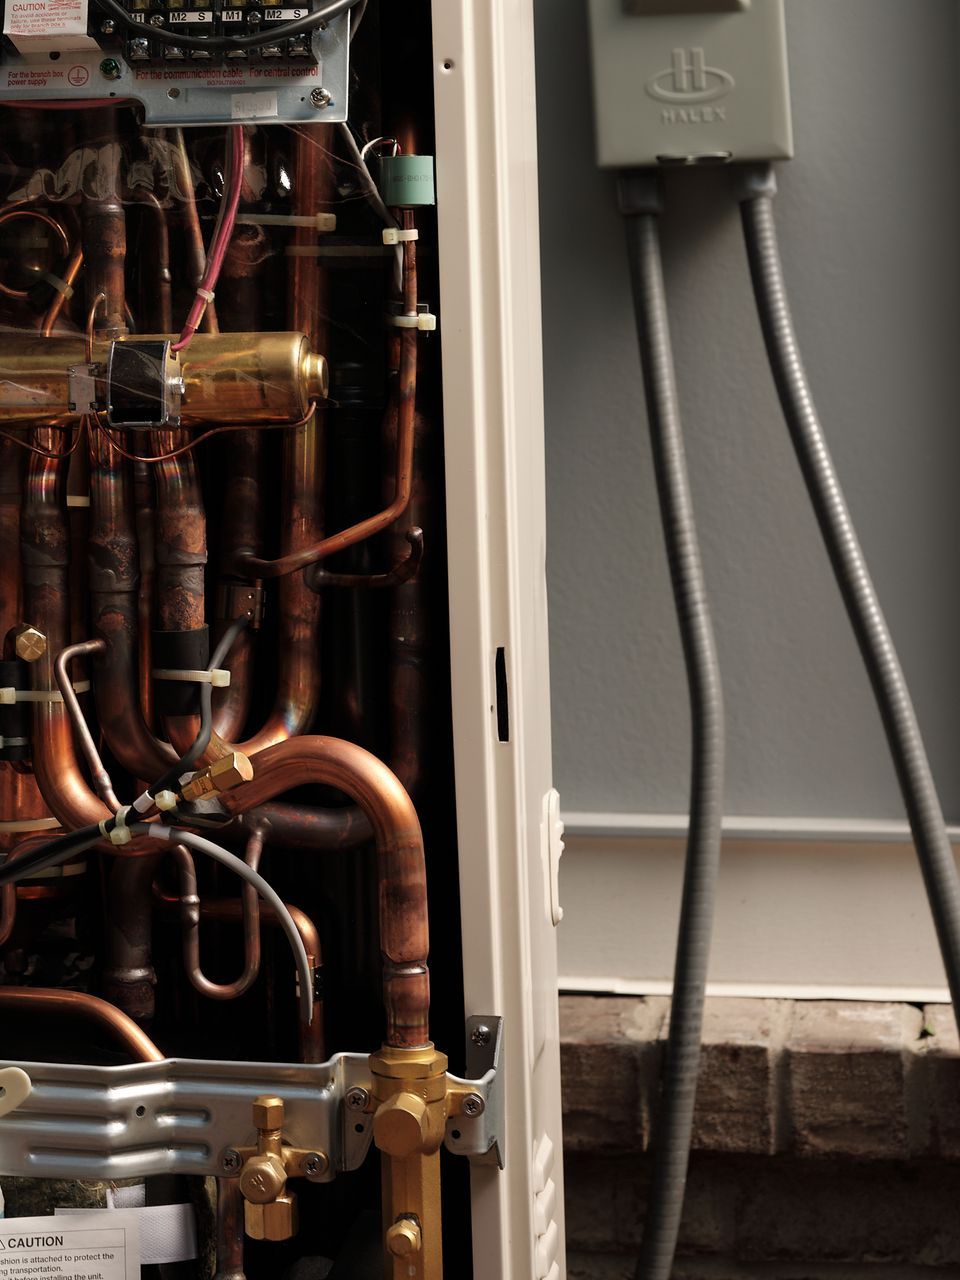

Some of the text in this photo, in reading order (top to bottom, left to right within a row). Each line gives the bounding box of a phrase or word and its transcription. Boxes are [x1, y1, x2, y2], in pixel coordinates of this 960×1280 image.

[12, 3, 45, 12] CAUTION
[171, 12, 206, 21] M2 S
[225, 12, 240, 20] M1
[267, 10, 301, 19] M2 S
[136, 69, 243, 80] For the communication cable
[249, 67, 319, 76] For central control
[660, 107, 726, 125] HALEX
[8, 1236, 64, 1248] CAUTION
[30, 1255, 63, 1264] attached
[74, 1253, 100, 1264] protect
[9, 1265, 63, 1277] transportation.
